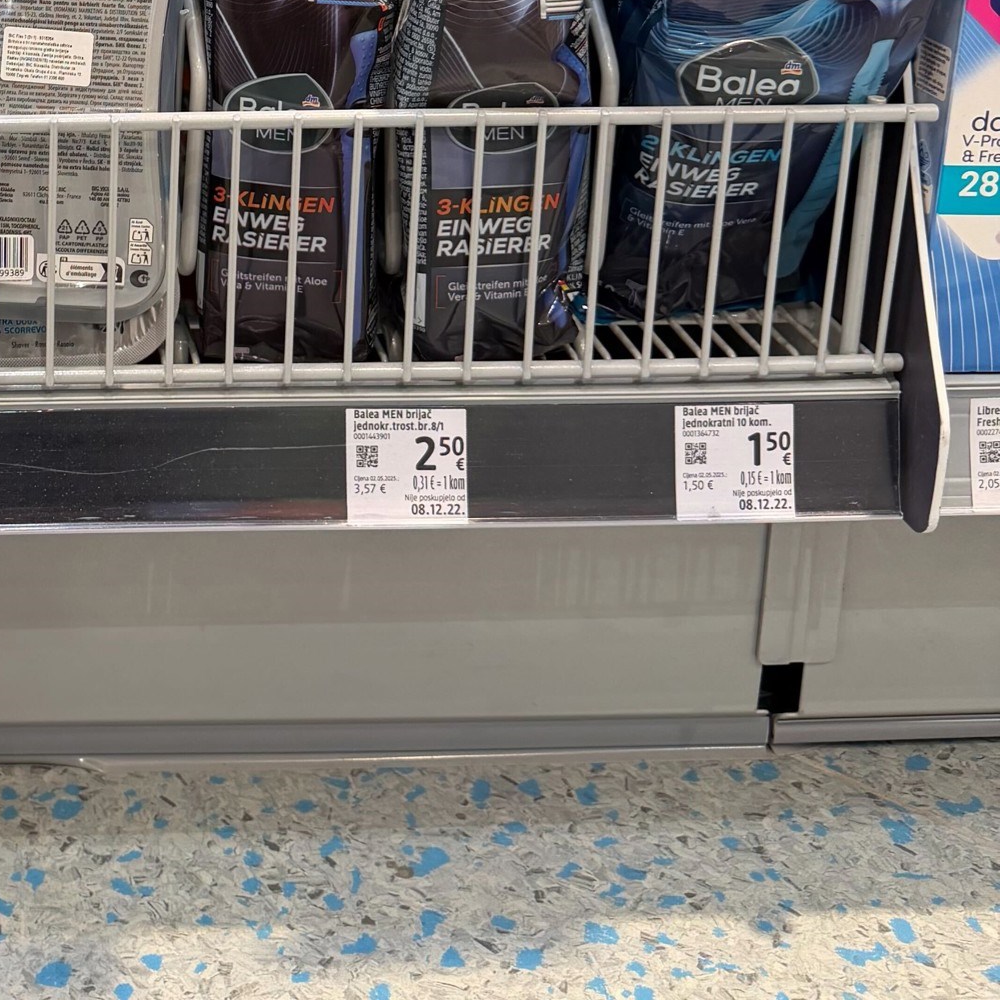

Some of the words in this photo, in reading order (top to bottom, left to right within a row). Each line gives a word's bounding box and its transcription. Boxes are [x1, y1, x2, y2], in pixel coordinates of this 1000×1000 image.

[696, 64, 800, 96] Balea
[354, 410, 379, 419] Balea
[382, 410, 402, 418] MEN
[406, 409, 432, 420] brijač
[683, 408, 708, 416] Balea
[710, 407, 731, 415] MEN
[734, 406, 759, 416] brijač
[682, 419, 734, 429] jednokratni
[737, 418, 746, 426] 10
[749, 418, 771, 426] kom.
[412, 504, 465, 515] 08.12.22.
[739, 498, 792, 510] 08.12.22.
